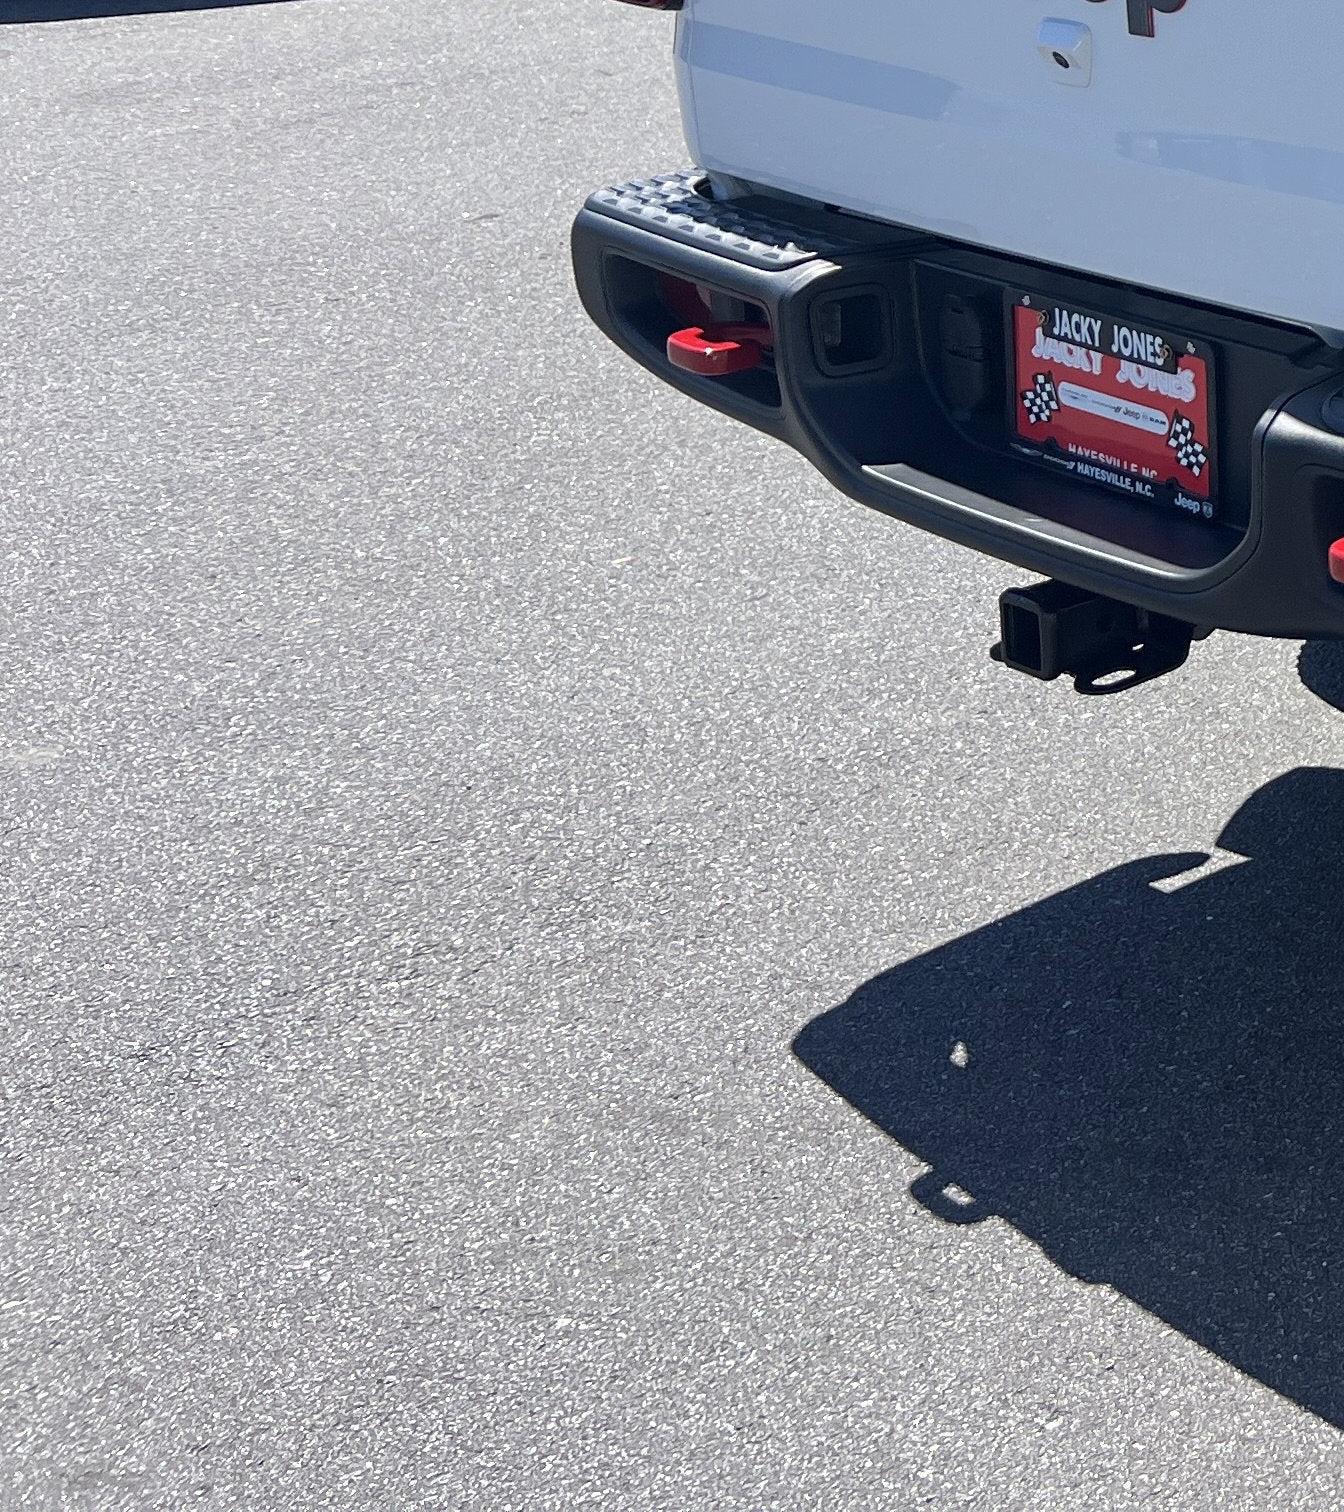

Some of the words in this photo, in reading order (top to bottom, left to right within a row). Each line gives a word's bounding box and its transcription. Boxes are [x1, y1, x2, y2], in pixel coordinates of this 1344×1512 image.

[1052, 307, 1102, 347] JACKY
[1111, 325, 1166, 366] JONES
[1076, 461, 1134, 493] HAYESVILLE,
[1174, 492, 1201, 514] Jeep
